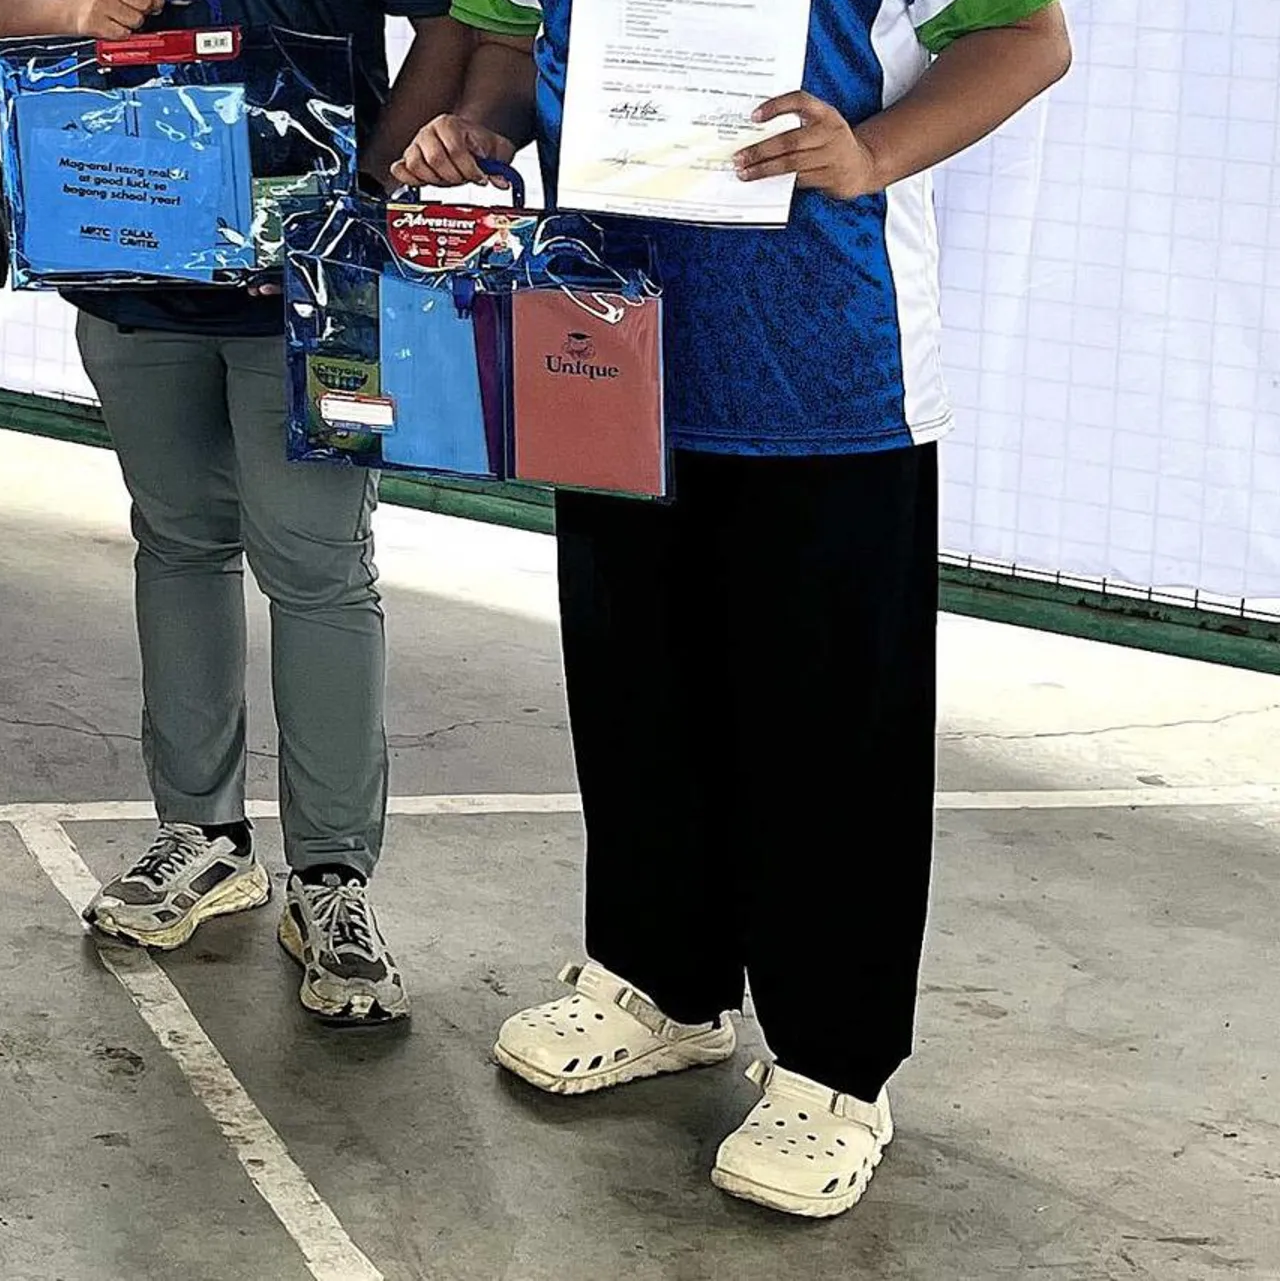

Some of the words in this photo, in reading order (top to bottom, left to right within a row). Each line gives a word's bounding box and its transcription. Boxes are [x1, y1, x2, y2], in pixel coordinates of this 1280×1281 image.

[115, 165, 145, 177] nang
[94, 176, 124, 186] good
[126, 177, 150, 190] luck
[63, 183, 107, 199] bagong
[110, 189, 147, 202] school
[392, 213, 476, 229] Adventurer
[545, 354, 621, 381] Unique
